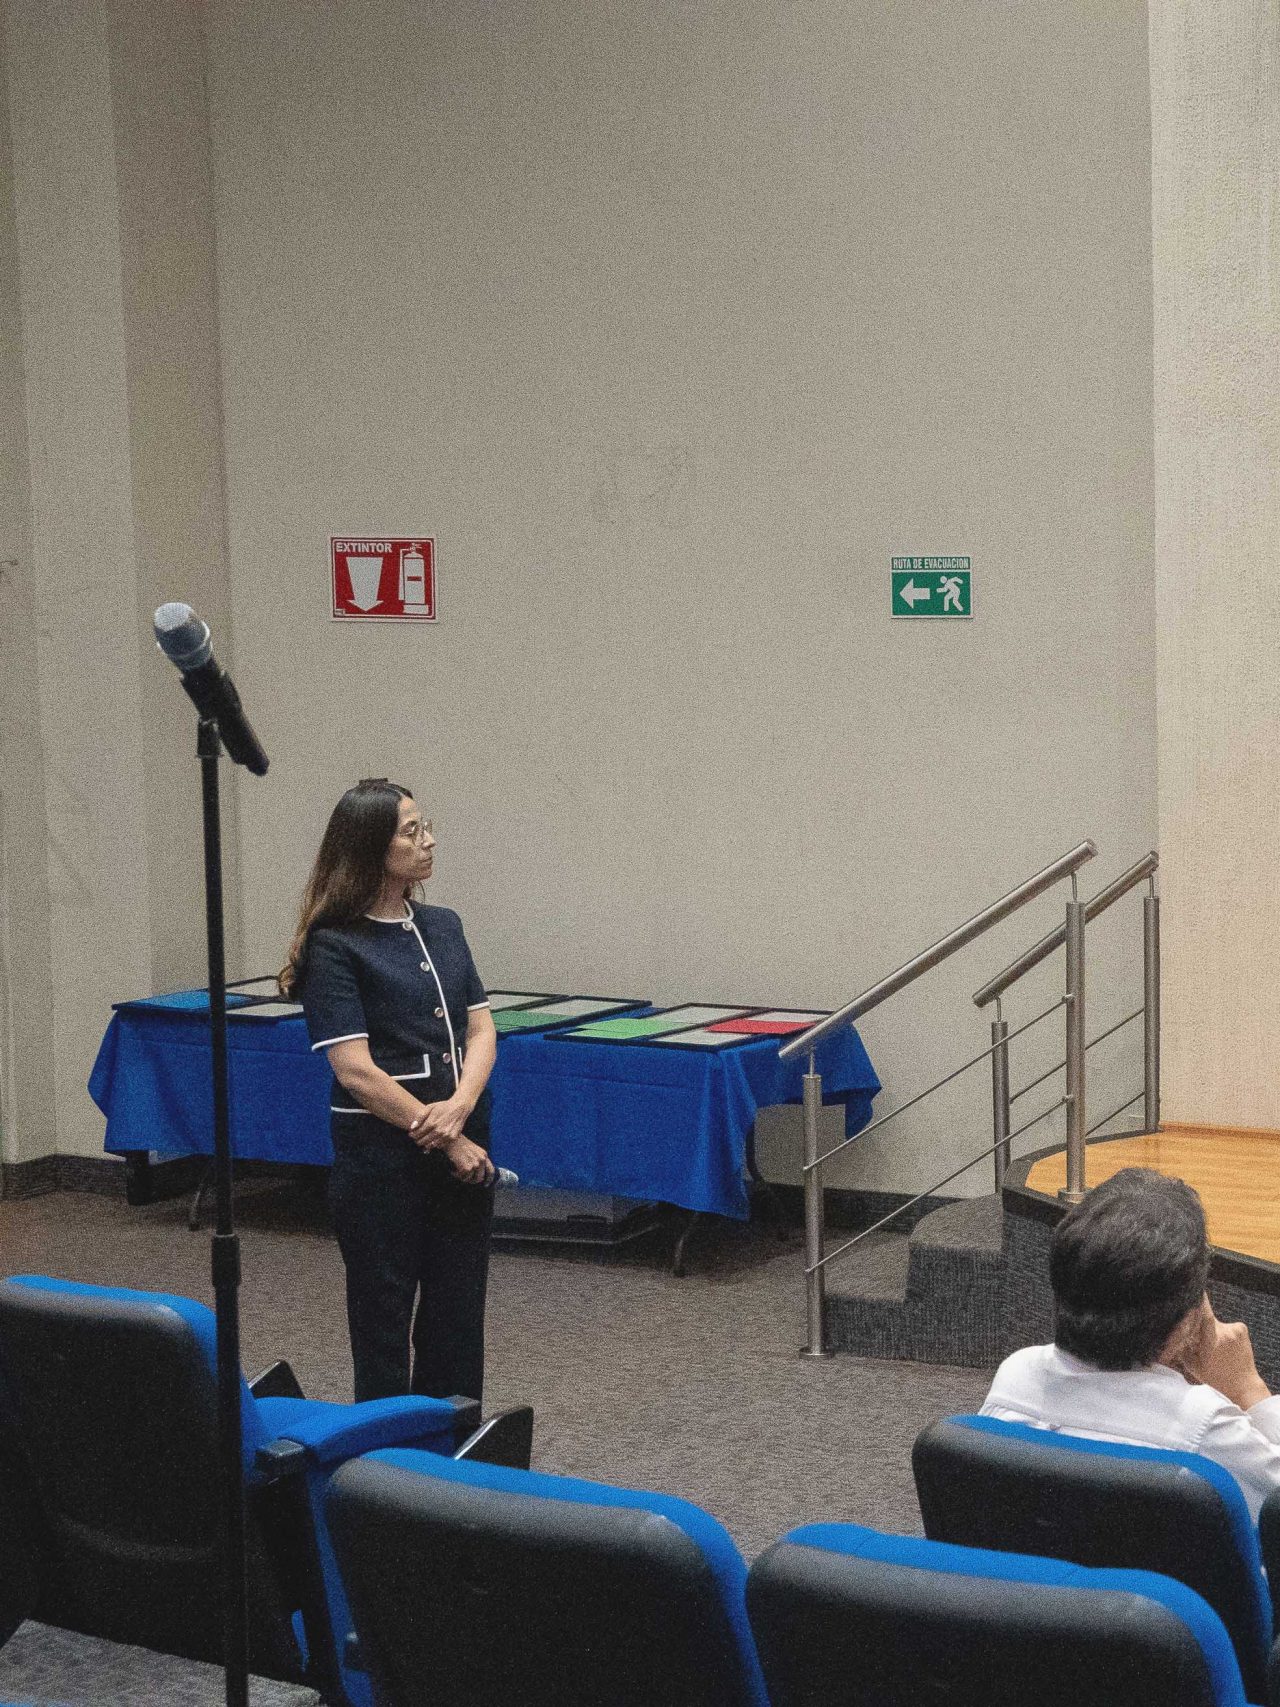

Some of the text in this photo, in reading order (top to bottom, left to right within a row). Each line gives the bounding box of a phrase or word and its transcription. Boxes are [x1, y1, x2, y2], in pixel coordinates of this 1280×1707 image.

[336, 542, 393, 553] EXTINTOR
[893, 558, 912, 569] RUTA
[913, 558, 923, 569] DE
